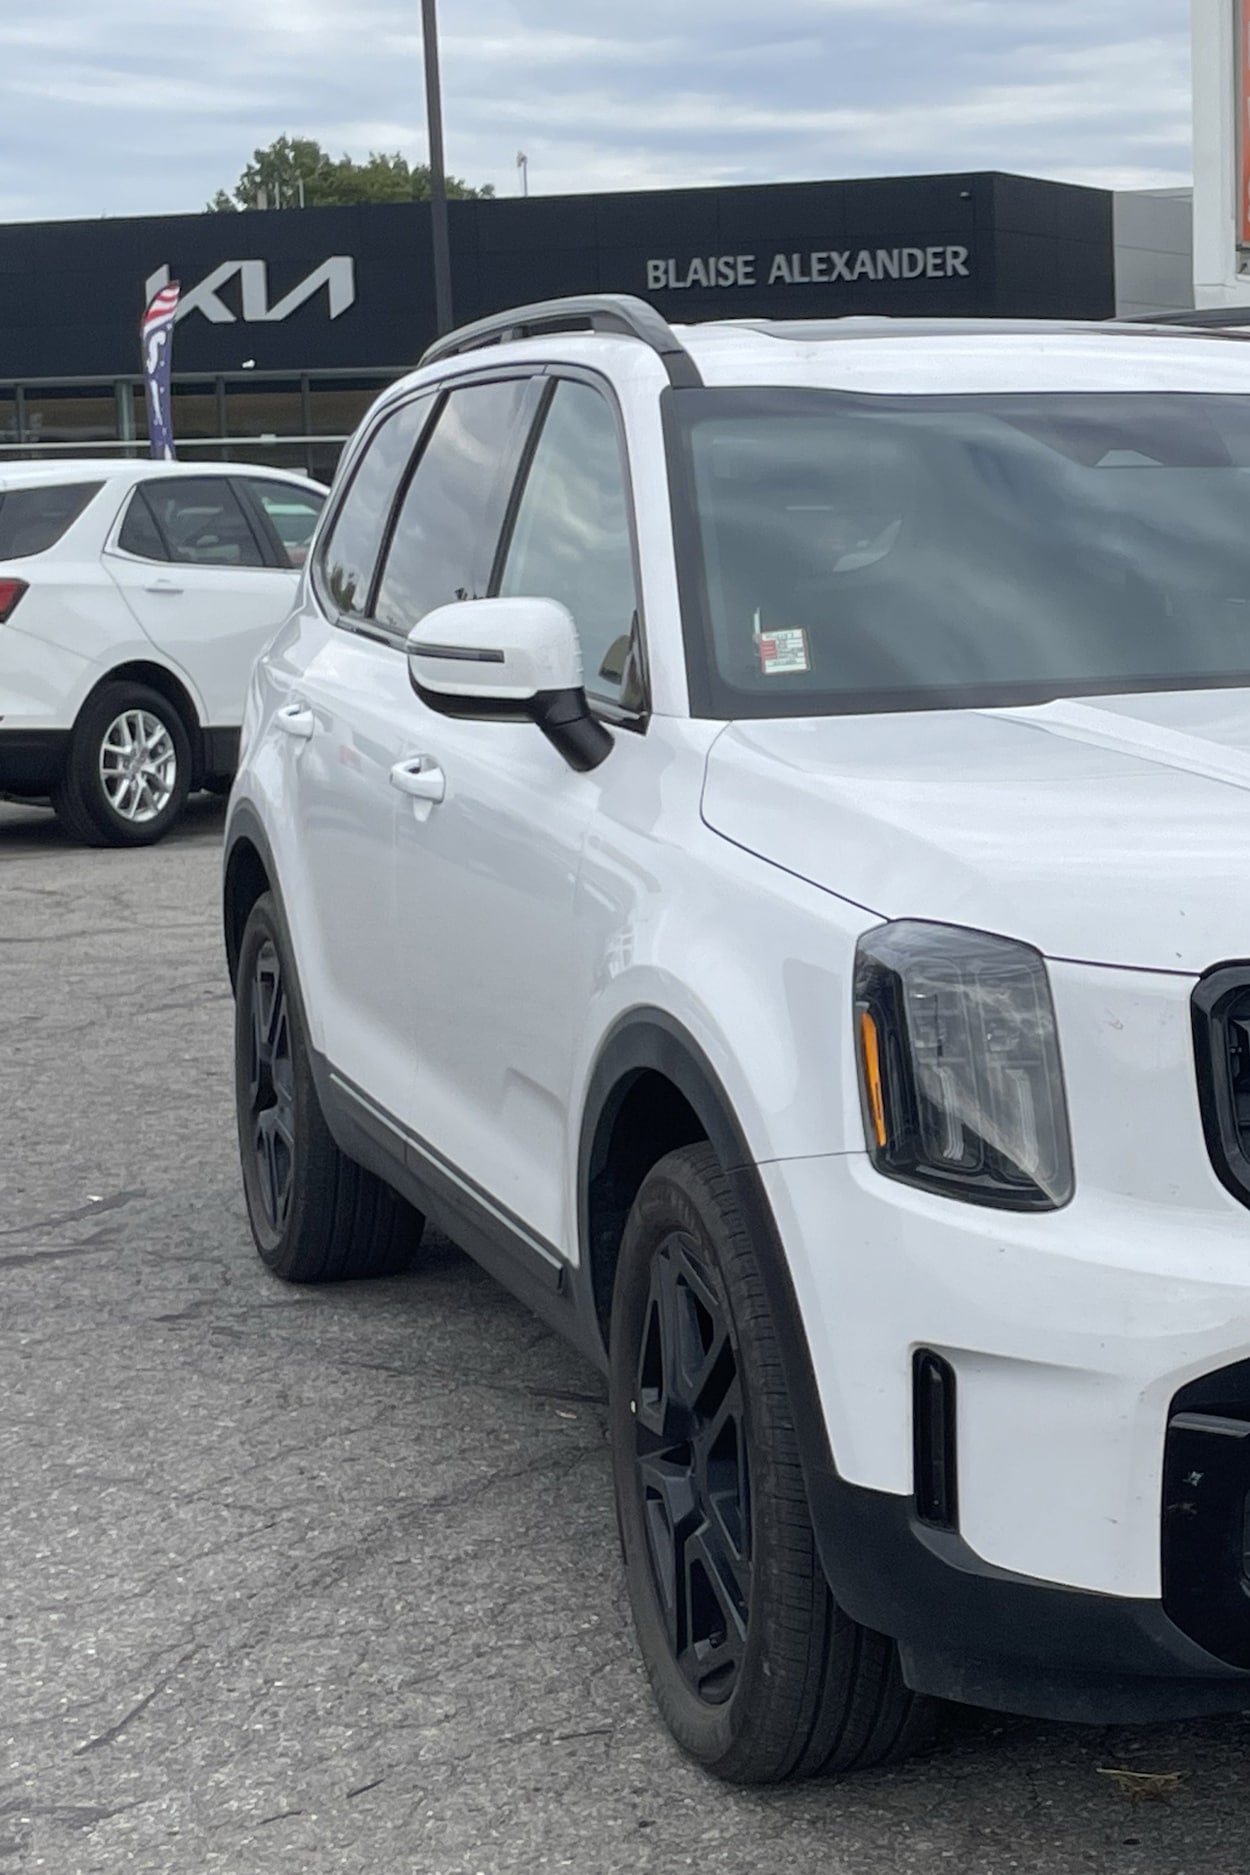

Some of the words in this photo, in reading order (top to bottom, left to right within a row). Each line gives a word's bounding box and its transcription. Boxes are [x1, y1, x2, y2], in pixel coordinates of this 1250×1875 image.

[145, 255, 355, 323] KIA
[646, 254, 756, 290] BLAISE
[767, 246, 970, 285] ALEXANDER
